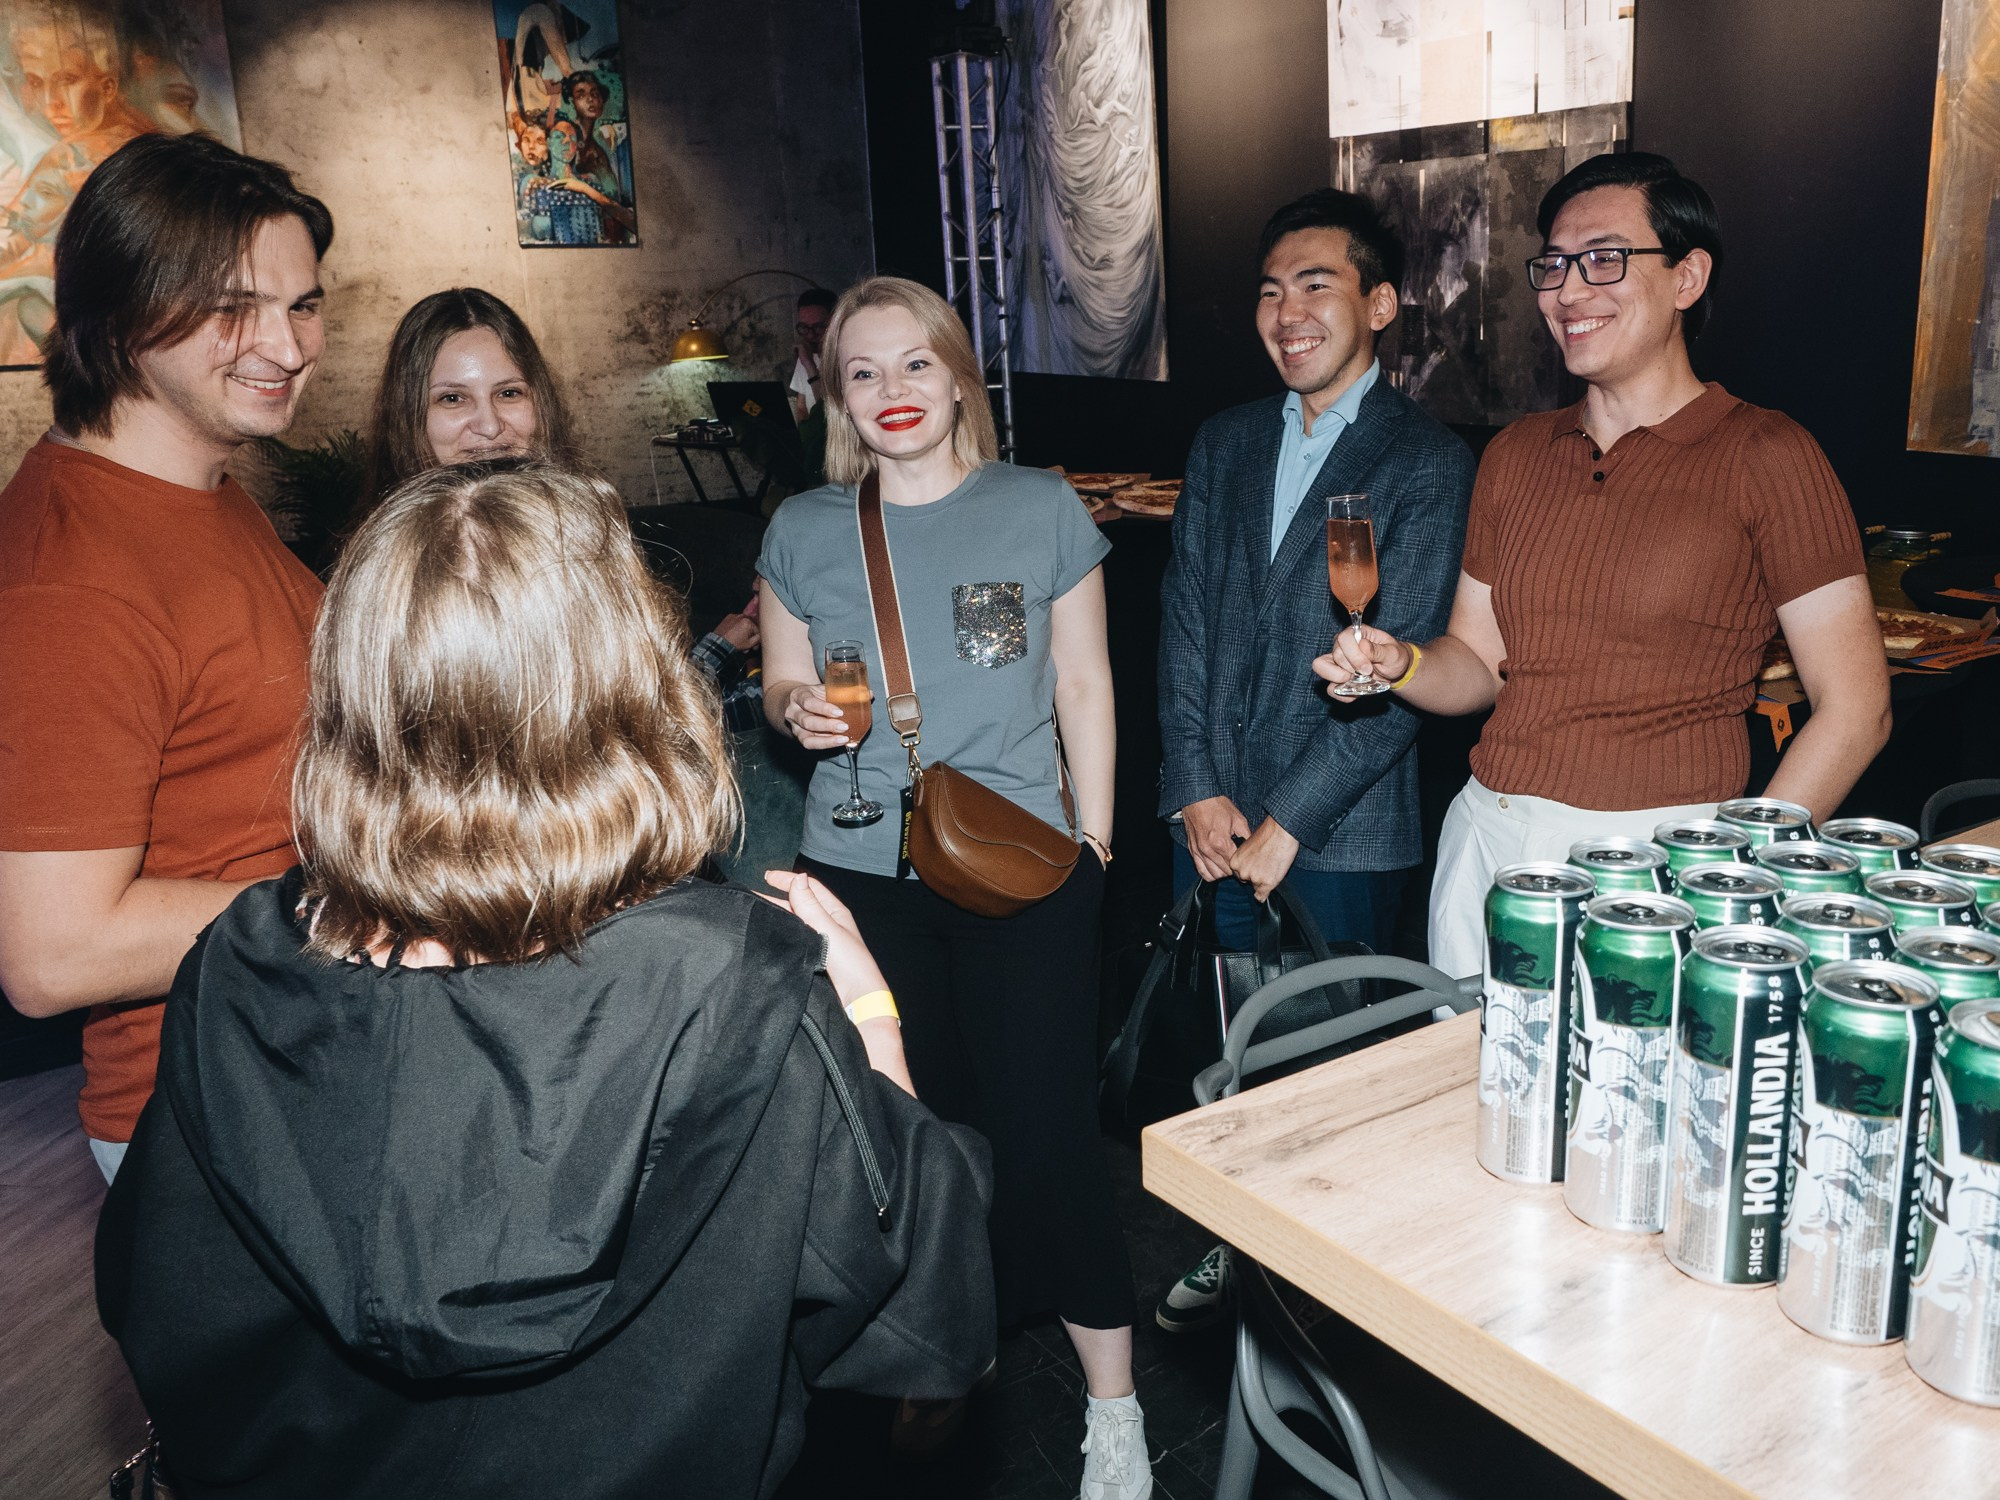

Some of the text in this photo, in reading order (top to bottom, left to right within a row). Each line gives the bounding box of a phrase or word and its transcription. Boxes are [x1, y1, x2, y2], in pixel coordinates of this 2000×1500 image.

[1742, 975, 1790, 1276] SINCE HOLLANDIA 1758
